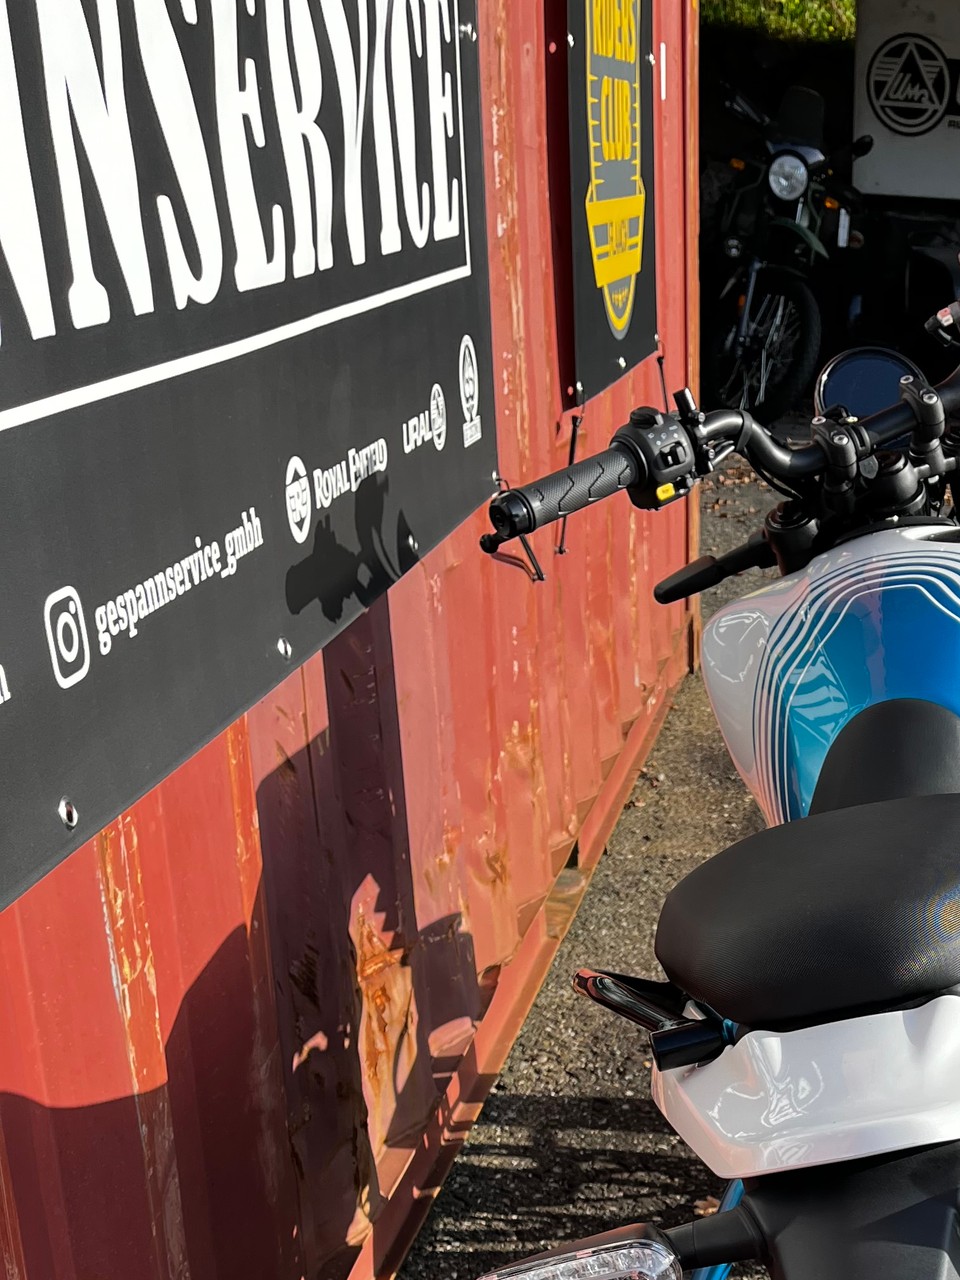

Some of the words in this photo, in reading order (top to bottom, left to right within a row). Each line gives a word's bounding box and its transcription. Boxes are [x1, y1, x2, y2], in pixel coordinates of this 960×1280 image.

[601, 75, 632, 161] CLUB
[0, 0, 460, 342] NSERVICE
[402, 409, 433, 454] URAL
[312, 460, 350, 510] ROYAL
[94, 506, 264, 656] gespannservice_gmbh
